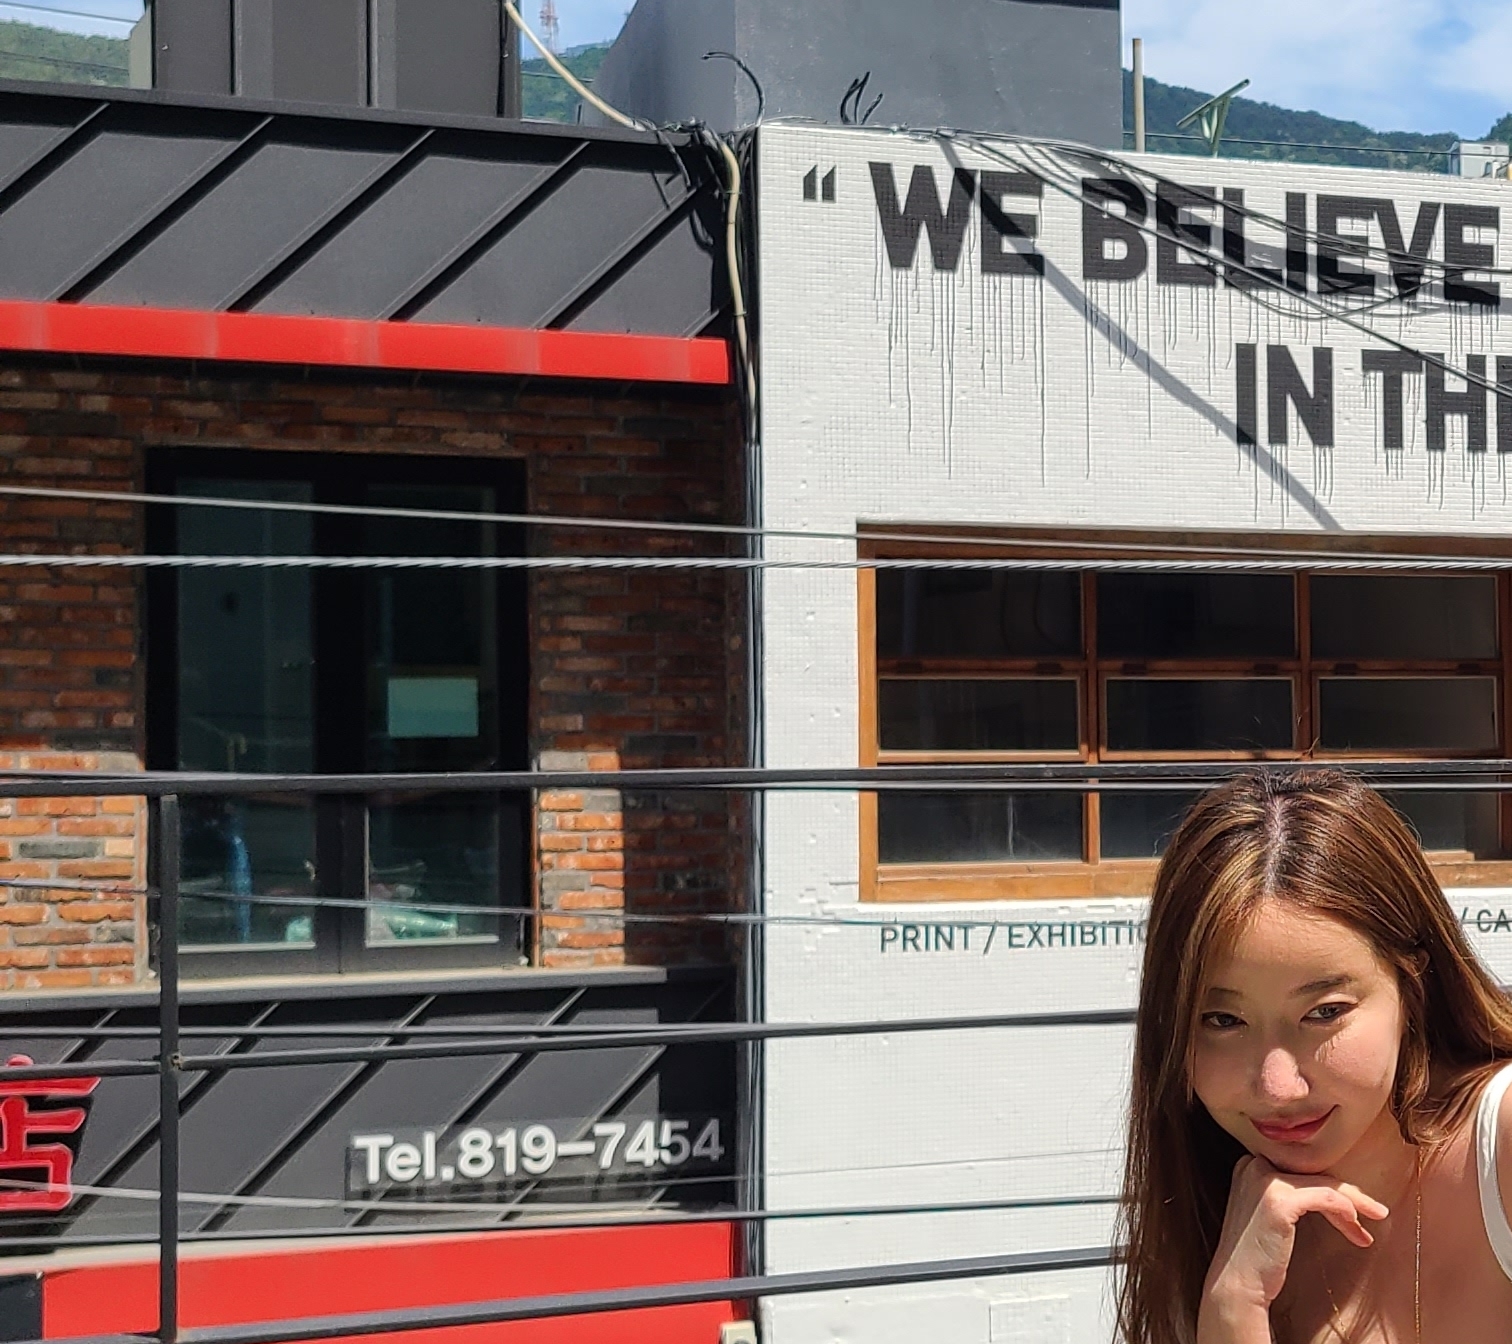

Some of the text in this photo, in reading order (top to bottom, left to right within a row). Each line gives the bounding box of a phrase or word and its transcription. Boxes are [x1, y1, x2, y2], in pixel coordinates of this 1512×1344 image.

[869, 162, 1045, 276] WE
[1082, 178, 1501, 306] BELIEVE
[1236, 343, 1335, 447] IN
[880, 922, 976, 953] PRINT
